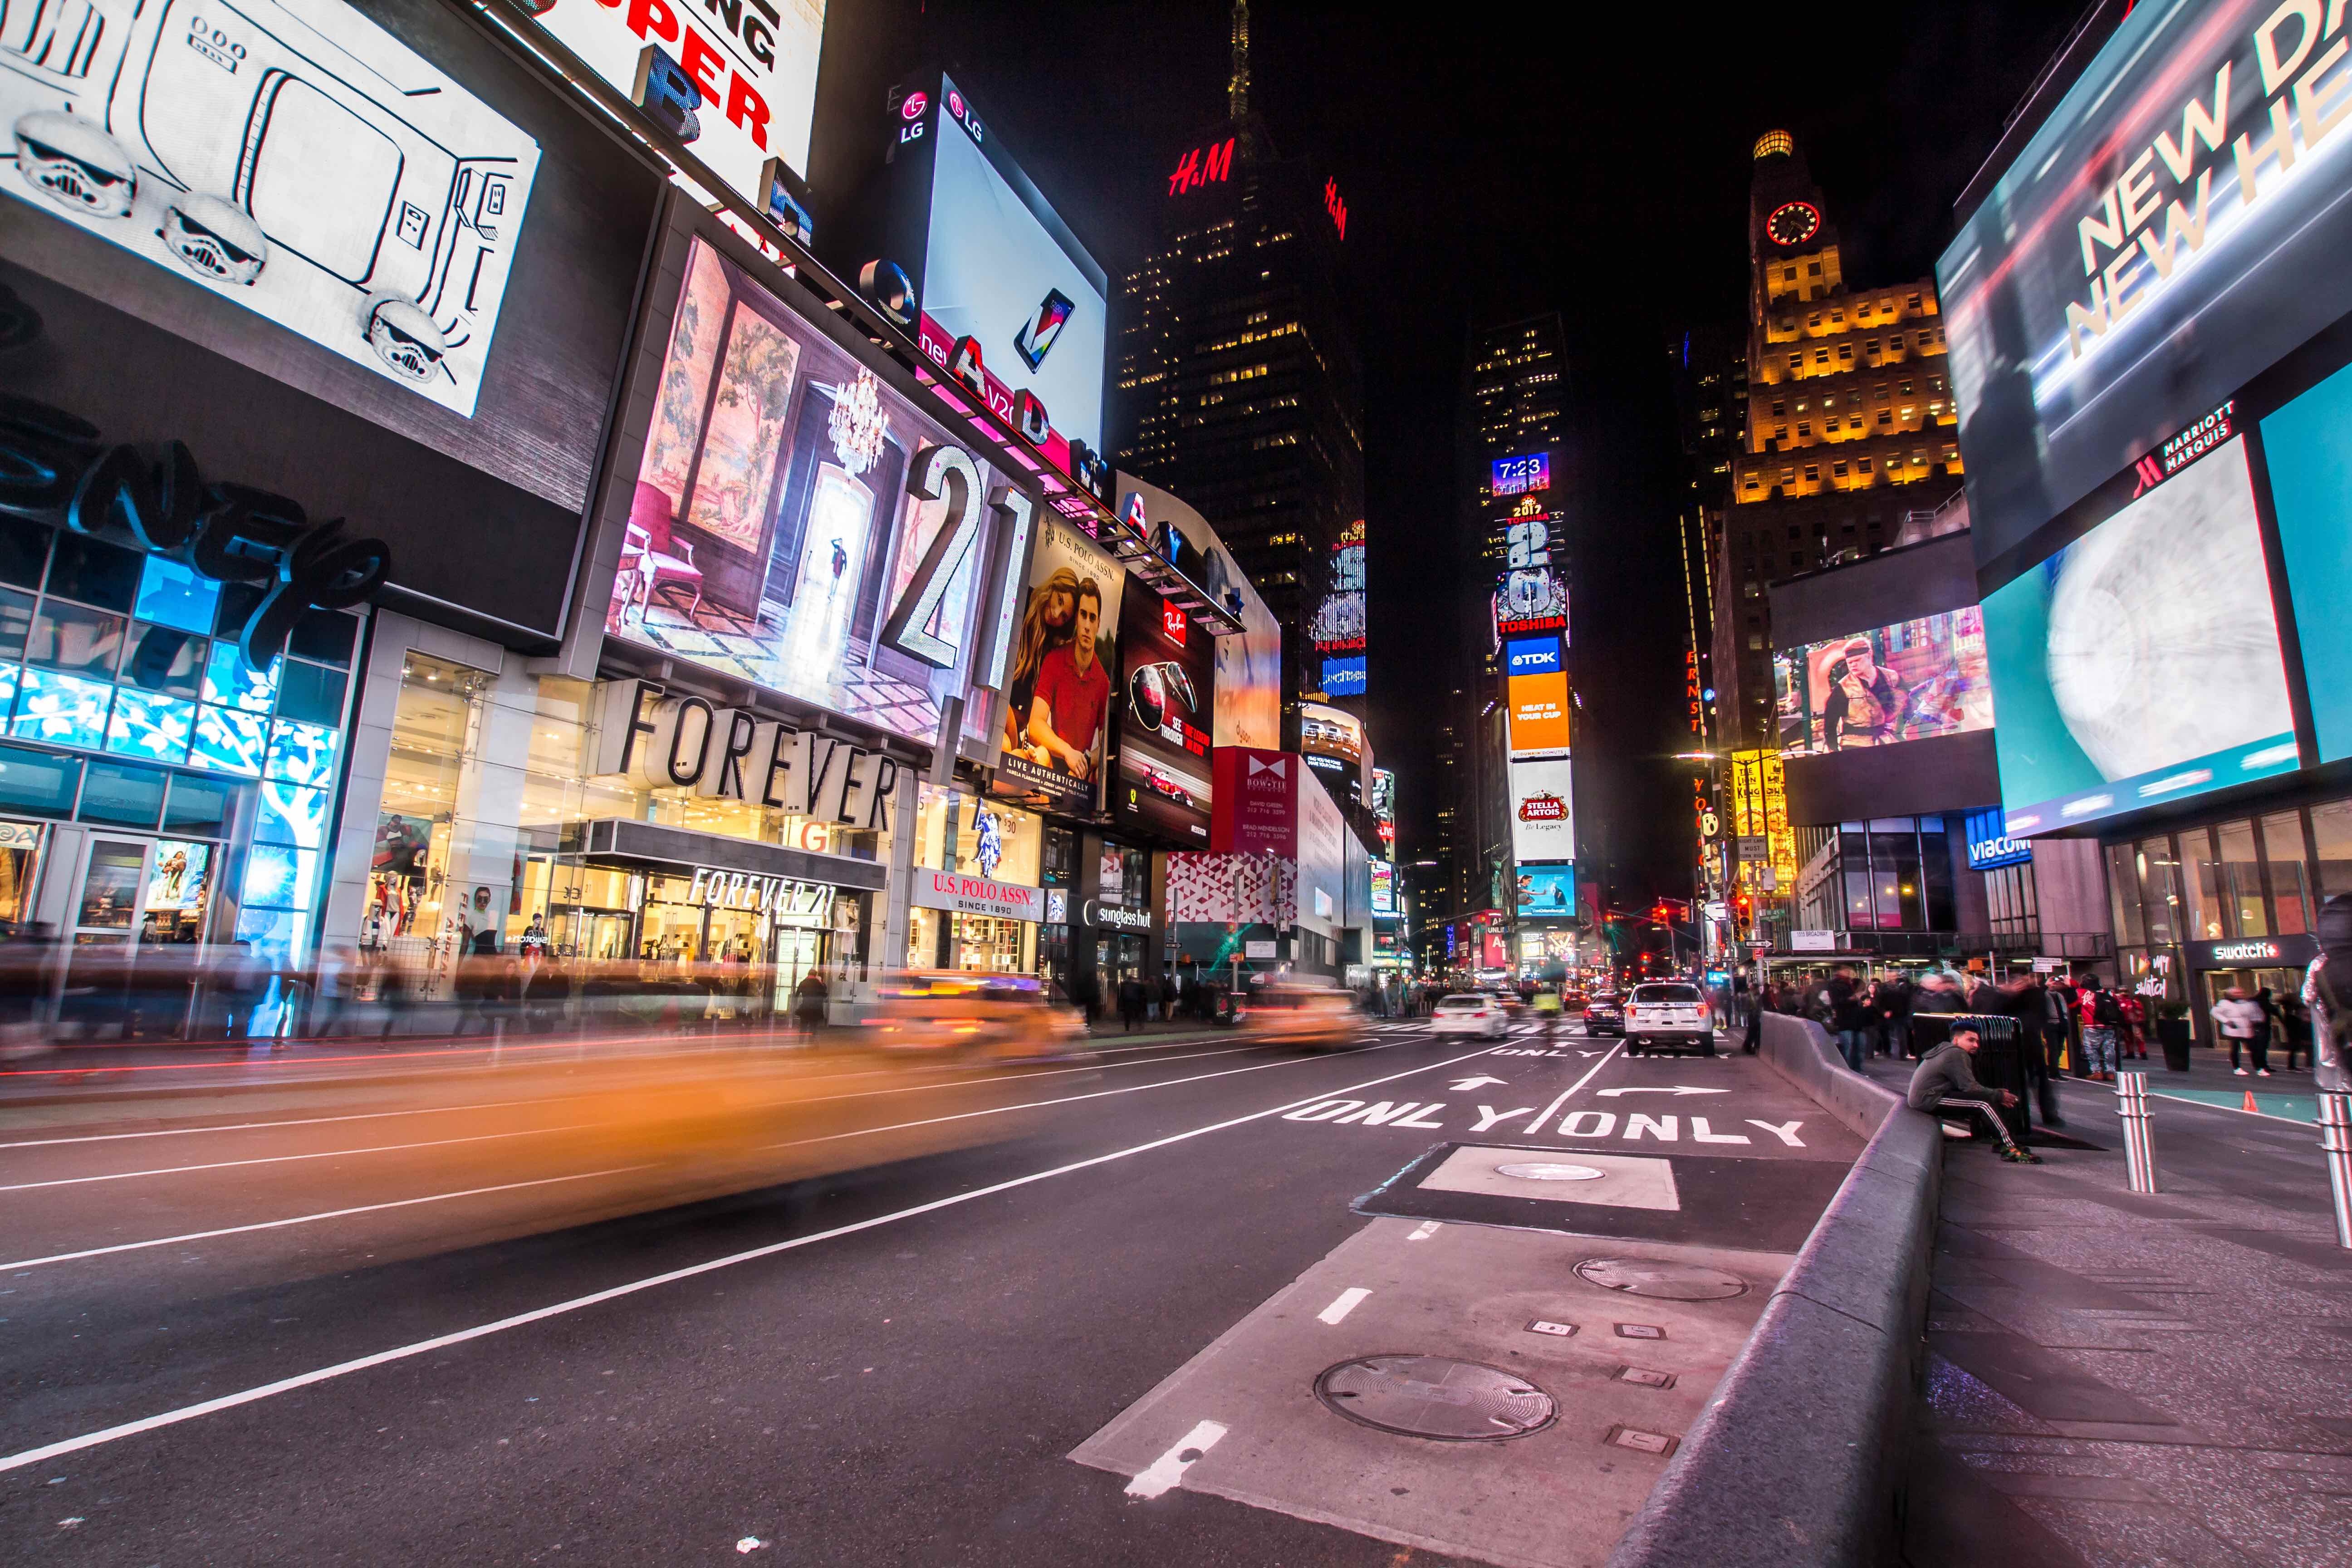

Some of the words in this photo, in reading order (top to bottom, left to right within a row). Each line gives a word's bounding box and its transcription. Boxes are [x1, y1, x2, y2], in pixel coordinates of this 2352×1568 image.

[595, 0, 771, 153] PER
[901, 122, 924, 144] LG
[965, 109, 982, 143] LG
[1169, 137, 1234, 196] H&M
[2078, 61, 2232, 277] NEW
[1324, 176, 1347, 241] H&M
[2065, 167, 2212, 359] NEW
[2163, 399, 2235, 457] MARRIOTT
[2166, 423, 2228, 472] MARQUIS
[1499, 459, 1540, 479] 7:23
[1506, 513, 1549, 525] TOSHIBA
[1513, 504, 1542, 517] 2017
[894, 444, 1032, 691] 21
[1058, 531, 1072, 550] U.S.
[1074, 543, 1094, 565] POLO
[1095, 559, 1114, 581] ASSN.
[1069, 556, 1085, 570] SINCE
[1498, 616, 1566, 633] TOSHIBA
[1523, 652, 1556, 665] TDK
[1686, 651, 1700, 732] ERNST
[1517, 712, 1542, 721] YOUR
[1521, 704, 1545, 712] HEAT
[1161, 724, 1183, 747] THROUGH
[1172, 716, 1182, 732] SEE
[1236, 720, 1251, 746] dyson
[619, 679, 898, 832] FOREVER
[1008, 758, 1027, 771] LIVE
[1030, 766, 1089, 792] AUTHENTICALLY
[1737, 776, 1756, 786] LIN
[1526, 802, 1560, 810] STELLA
[1526, 808, 1560, 817] ARTOIS
[1380, 828, 1393, 838] LIVE
[1536, 823, 1561, 832] Legacy
[688, 867, 805, 912] FOREVER
[808, 885, 836, 916] 21
[933, 874, 958, 895] U.S.
[961, 878, 997, 900] POLO
[999, 886, 1034, 906] ASSN.
[958, 900, 986, 911] SINCE
[990, 905, 1011, 914] 1890
[1100, 906, 1137, 929] sunglass
[1137, 909, 1151, 928] hut
[2214, 942, 2268, 960] swatch
[1490, 1049, 1605, 1058] ONLY
[1281, 1100, 1537, 1133] ONLY
[1557, 1111, 1807, 1147] ONLY
